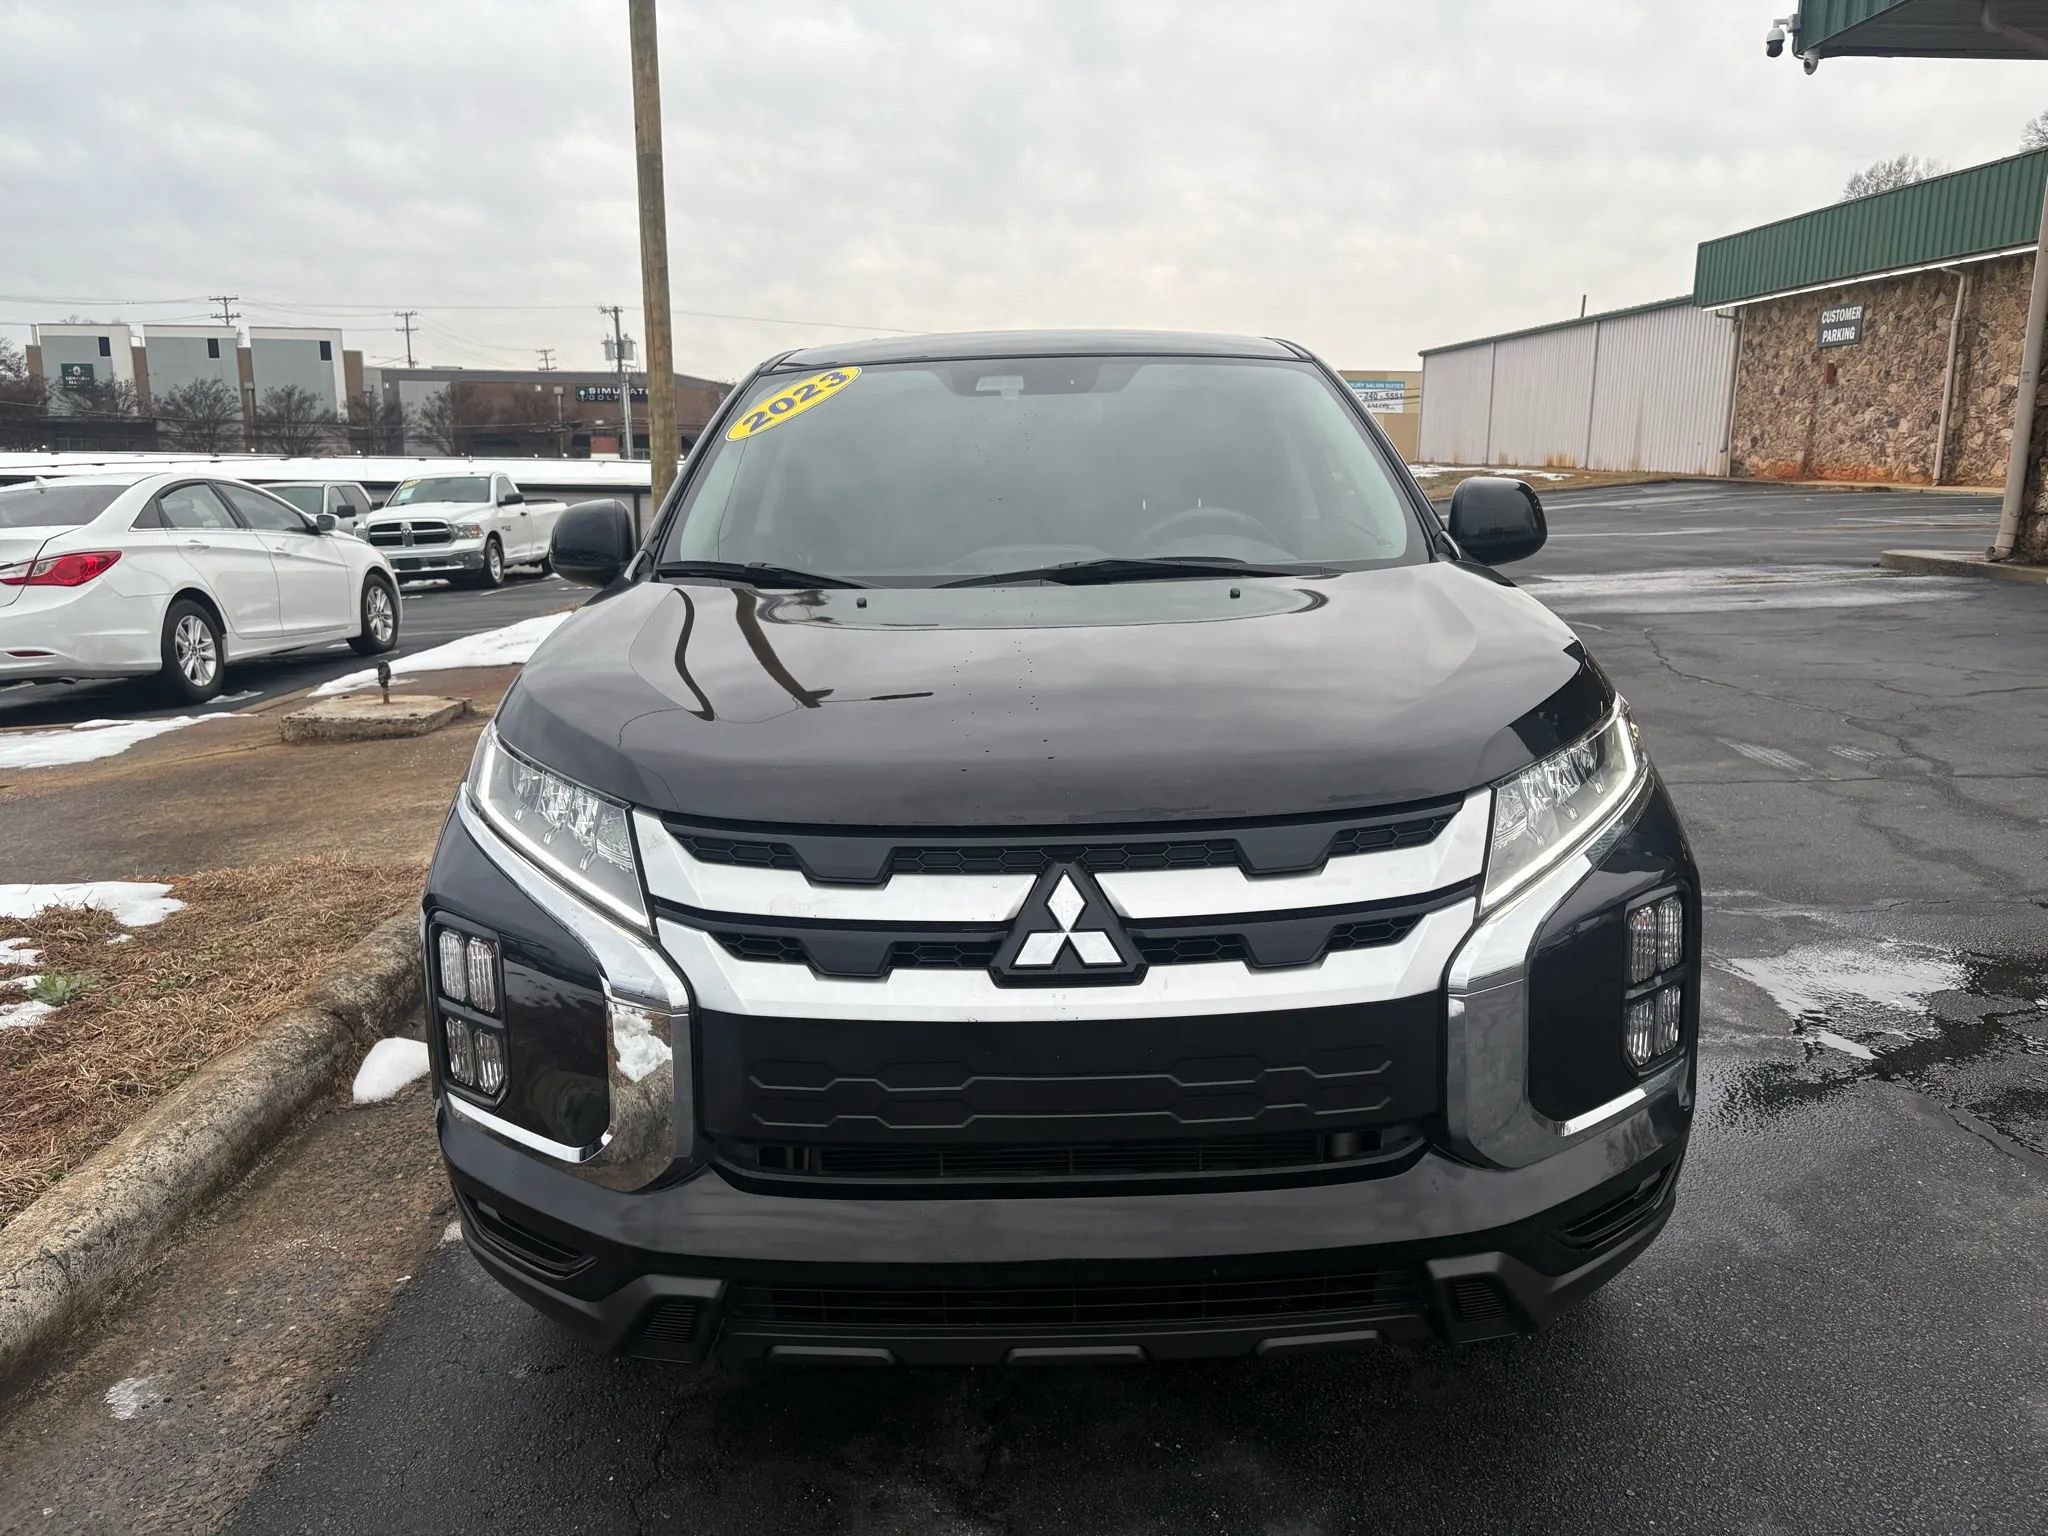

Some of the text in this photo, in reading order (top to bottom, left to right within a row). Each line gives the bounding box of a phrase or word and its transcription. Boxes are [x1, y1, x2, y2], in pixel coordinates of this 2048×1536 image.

[1821, 306, 1862, 324] CUSTOMER
[1822, 326, 1855, 343] PARKING
[588, 387, 649, 395] SIMUAT
[742, 371, 850, 432] 2023
